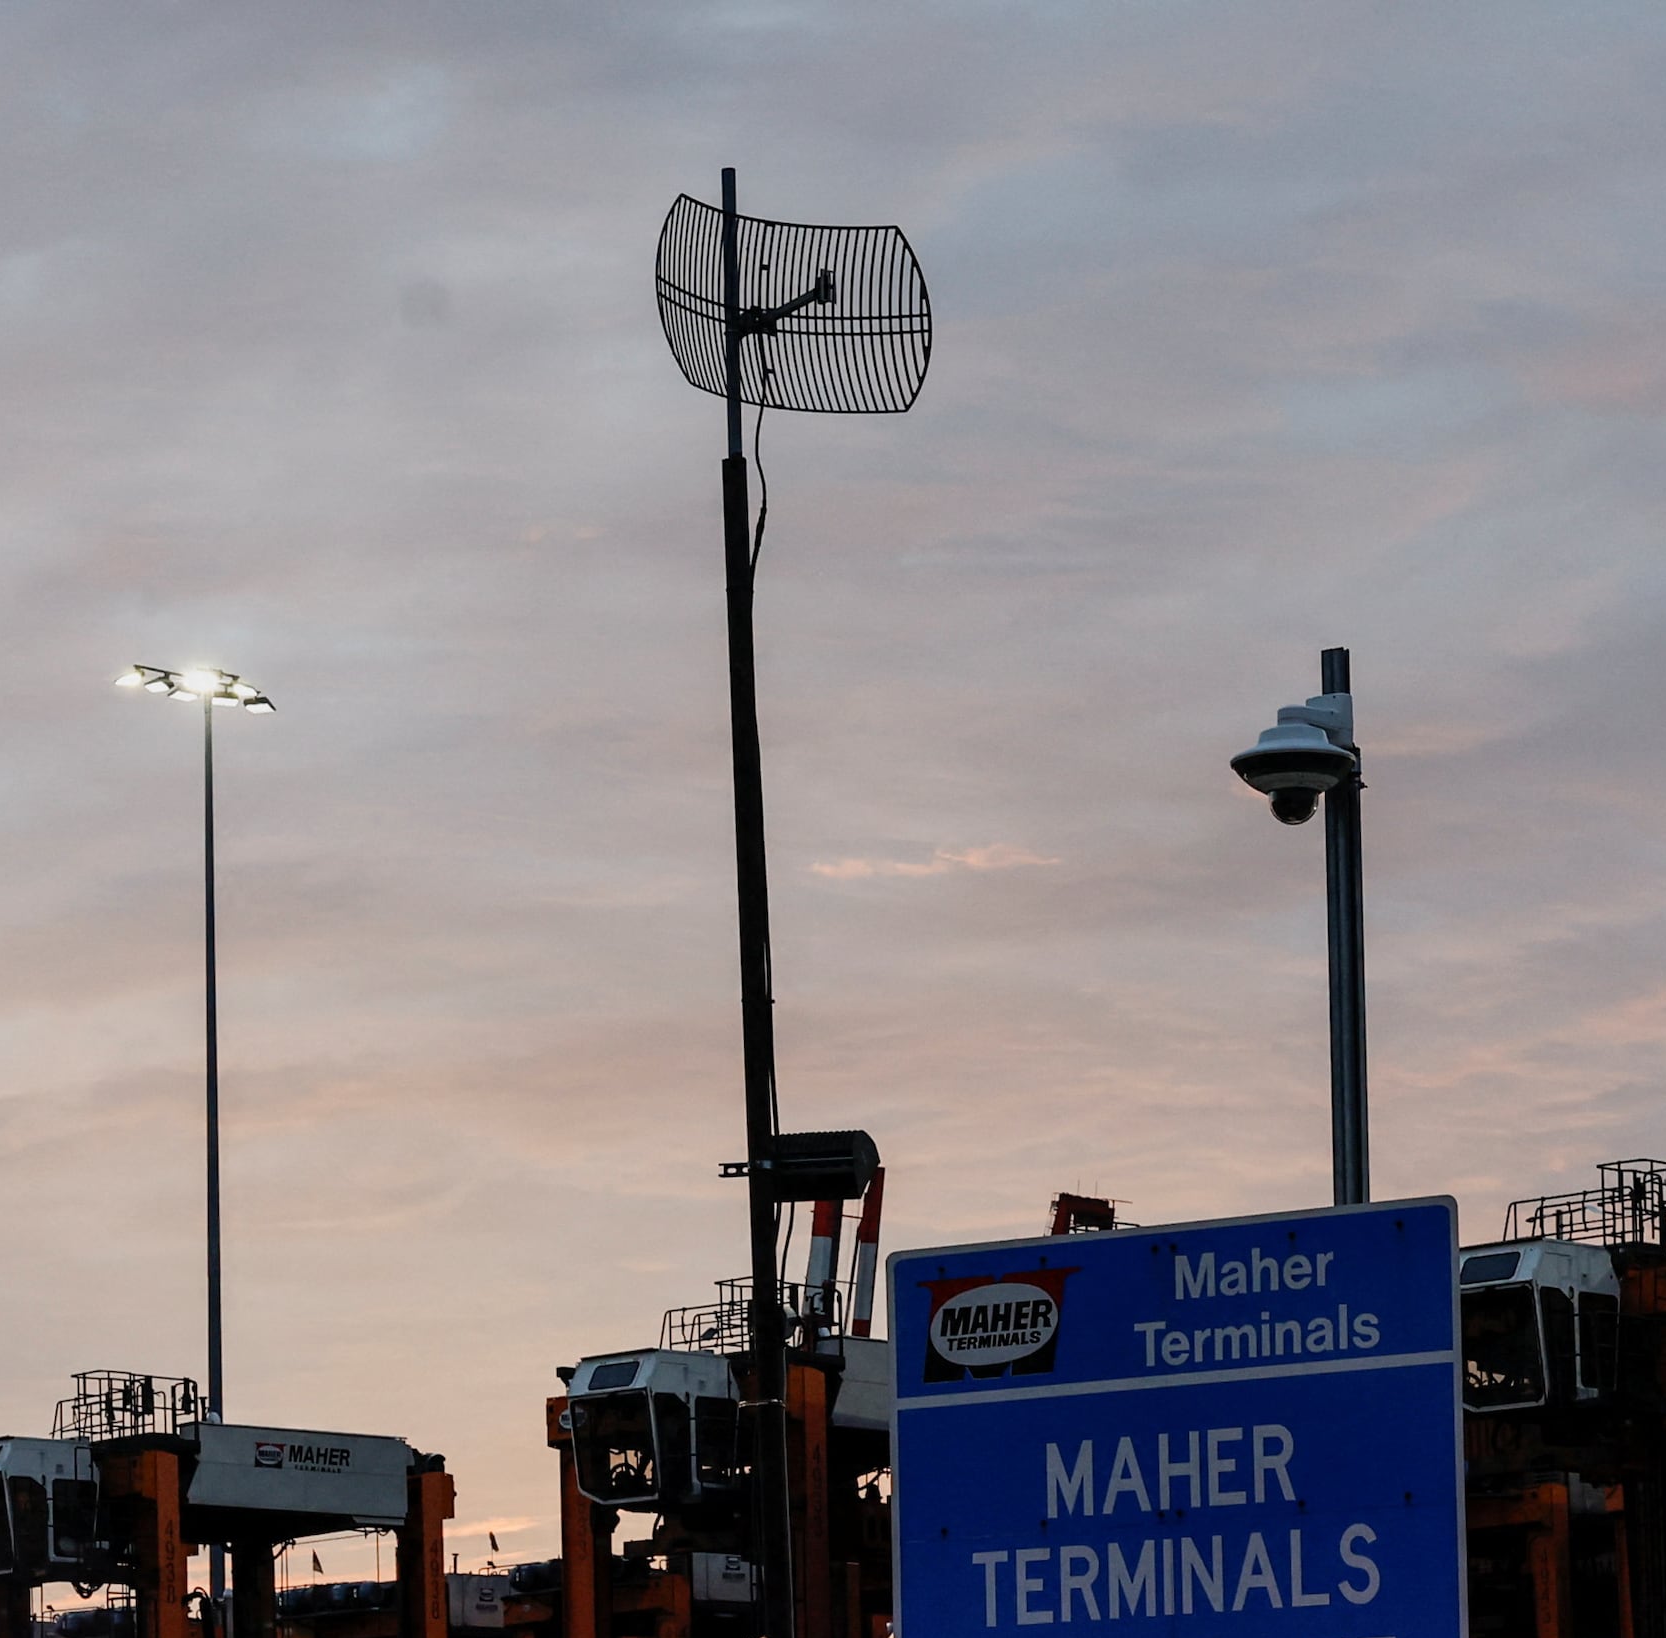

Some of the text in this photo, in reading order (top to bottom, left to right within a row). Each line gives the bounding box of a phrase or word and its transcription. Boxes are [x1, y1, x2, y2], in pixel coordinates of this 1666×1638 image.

[1174, 1249, 1334, 1300] Maher
[940, 1300, 1053, 1337] MAHER
[947, 1331, 1042, 1351] TERMINALS
[1133, 1304, 1381, 1368] Terminals
[289, 1445, 351, 1467] MAHER
[1044, 1424, 1297, 1519] MAHER
[972, 1523, 1381, 1628] TERMINALS
